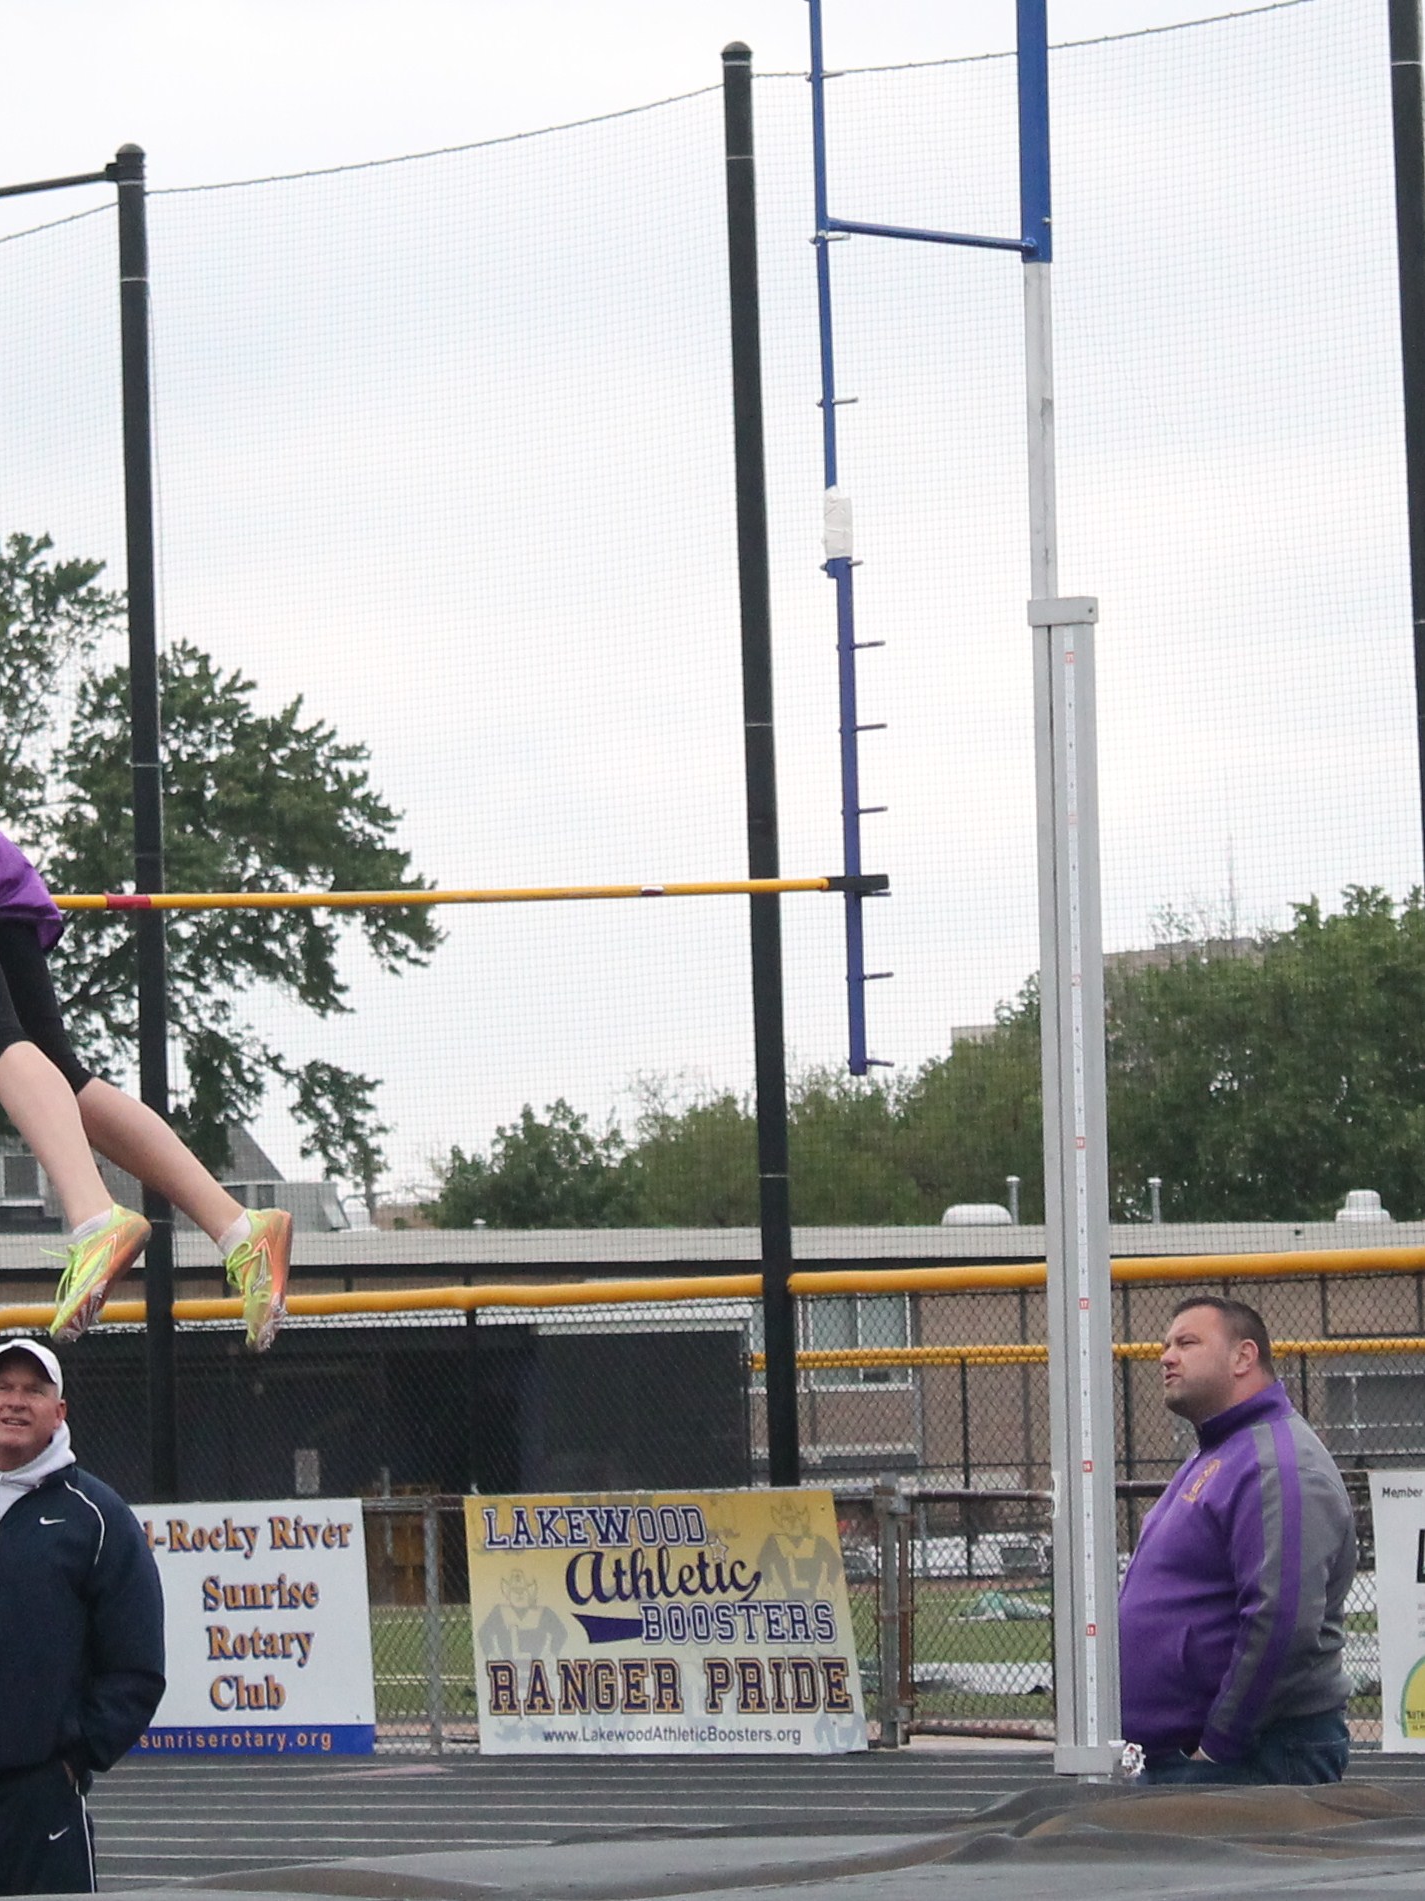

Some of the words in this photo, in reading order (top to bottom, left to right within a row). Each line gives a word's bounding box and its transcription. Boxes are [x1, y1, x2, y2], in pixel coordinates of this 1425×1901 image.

[268, 1515, 353, 1551] River
[482, 1506, 707, 1549] LAKEWOOD
[202, 1573, 320, 1612] Sunrise
[566, 1546, 761, 1605] Athletic
[640, 1601, 837, 1644] BOOSTERS
[206, 1624, 315, 1668] Rotary
[210, 1675, 287, 1712] Club
[486, 1658, 684, 1716] RANGER
[704, 1656, 854, 1714] PRIDE
[543, 1726, 802, 1746] www.LakewoodAthleticBoosters.org
